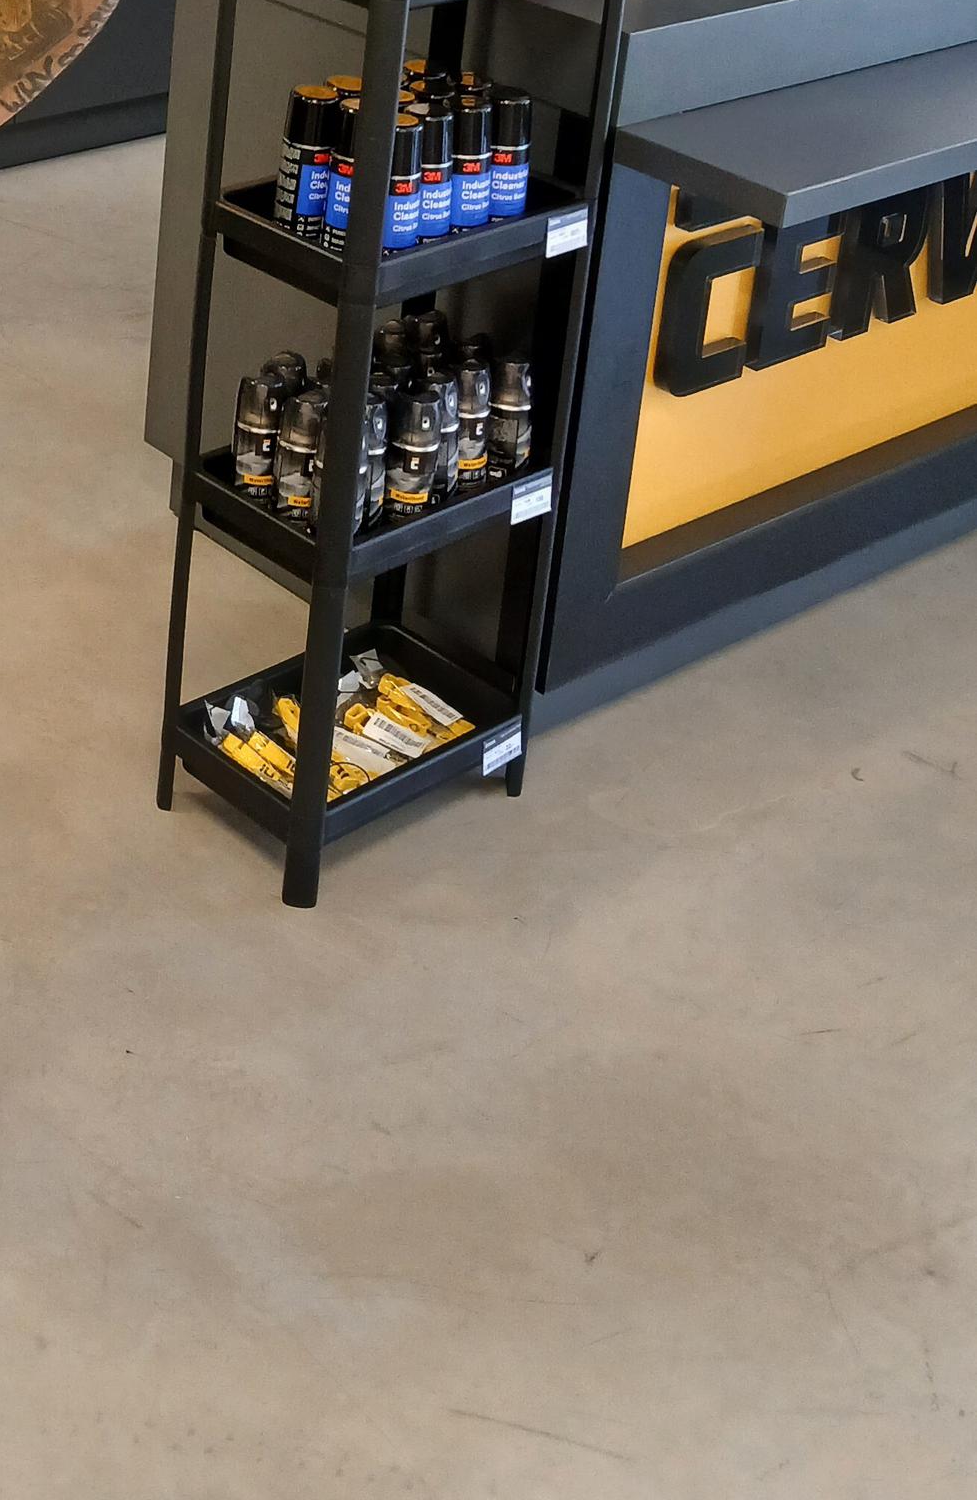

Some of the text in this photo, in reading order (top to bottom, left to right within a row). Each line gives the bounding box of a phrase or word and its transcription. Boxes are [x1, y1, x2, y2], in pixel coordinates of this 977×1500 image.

[494, 153, 512, 164] 3M
[462, 162, 481, 173] 3M
[423, 171, 442, 182] 3M
[395, 181, 413, 194] 3M
[490, 192, 513, 201] Citrus
